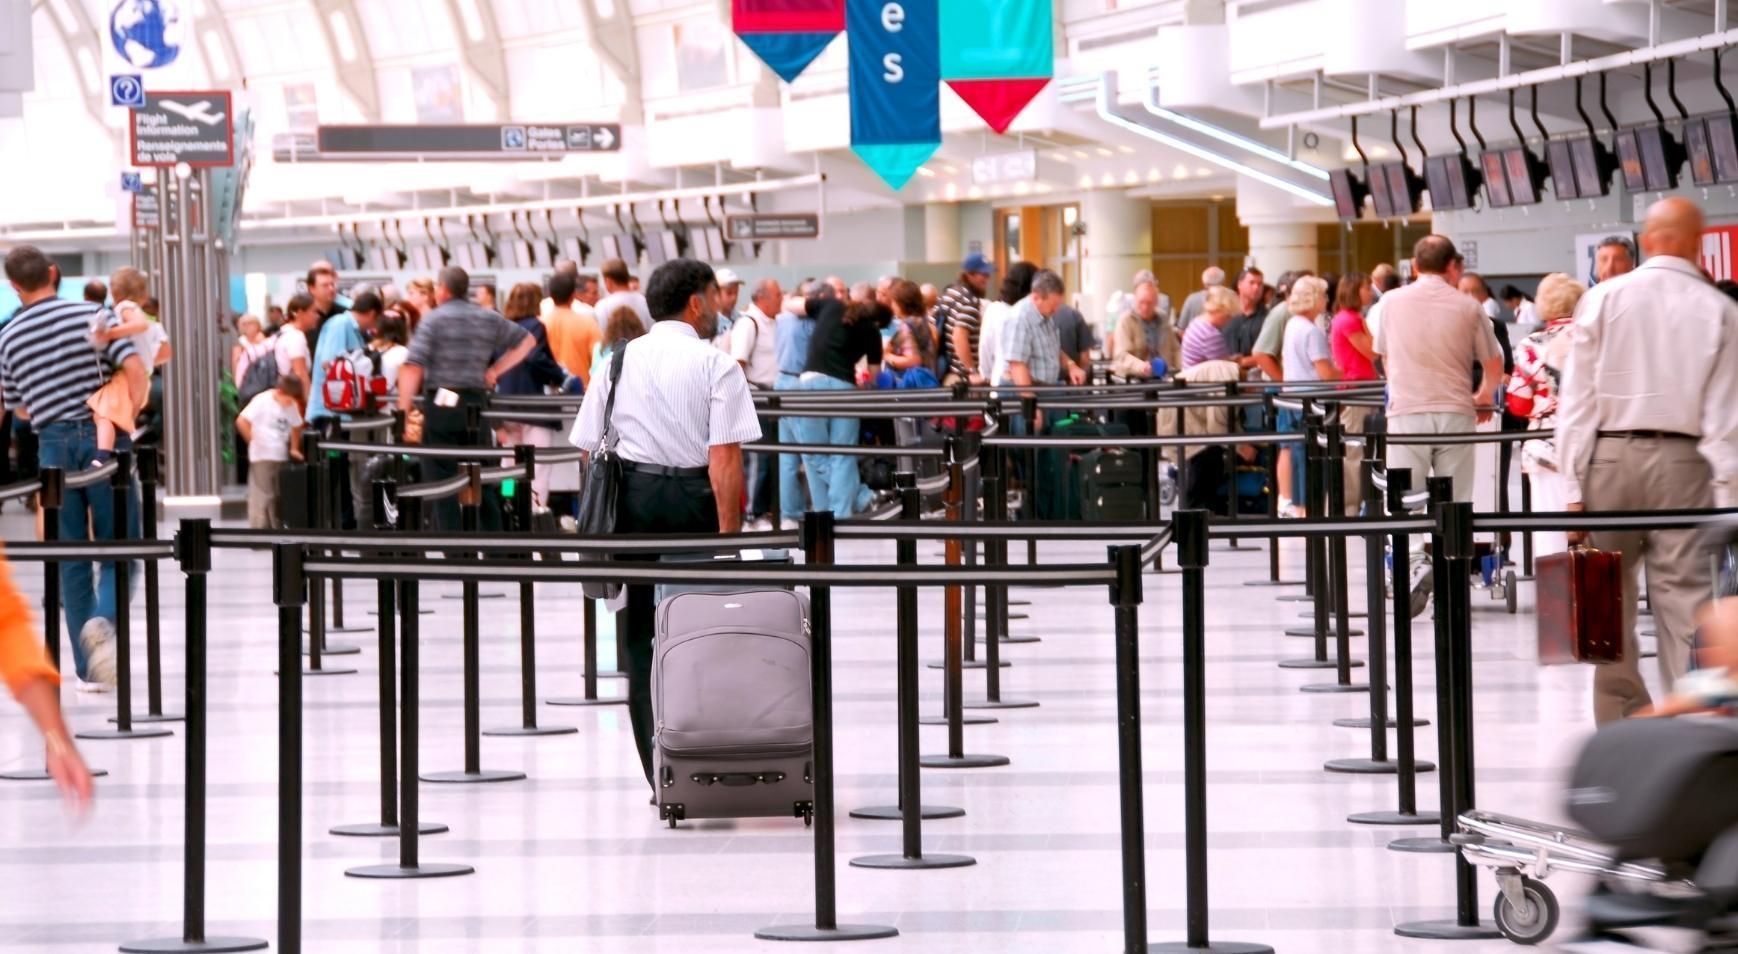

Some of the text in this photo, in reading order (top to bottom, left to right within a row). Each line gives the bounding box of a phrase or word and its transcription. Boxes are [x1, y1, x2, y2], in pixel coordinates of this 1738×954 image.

[136, 113, 168, 126] Flight
[137, 124, 199, 136] Information
[528, 127, 562, 138] Gates
[137, 140, 228, 153] Renseignements
[528, 138, 566, 150] Portes
[137, 152, 177, 162] de vols
